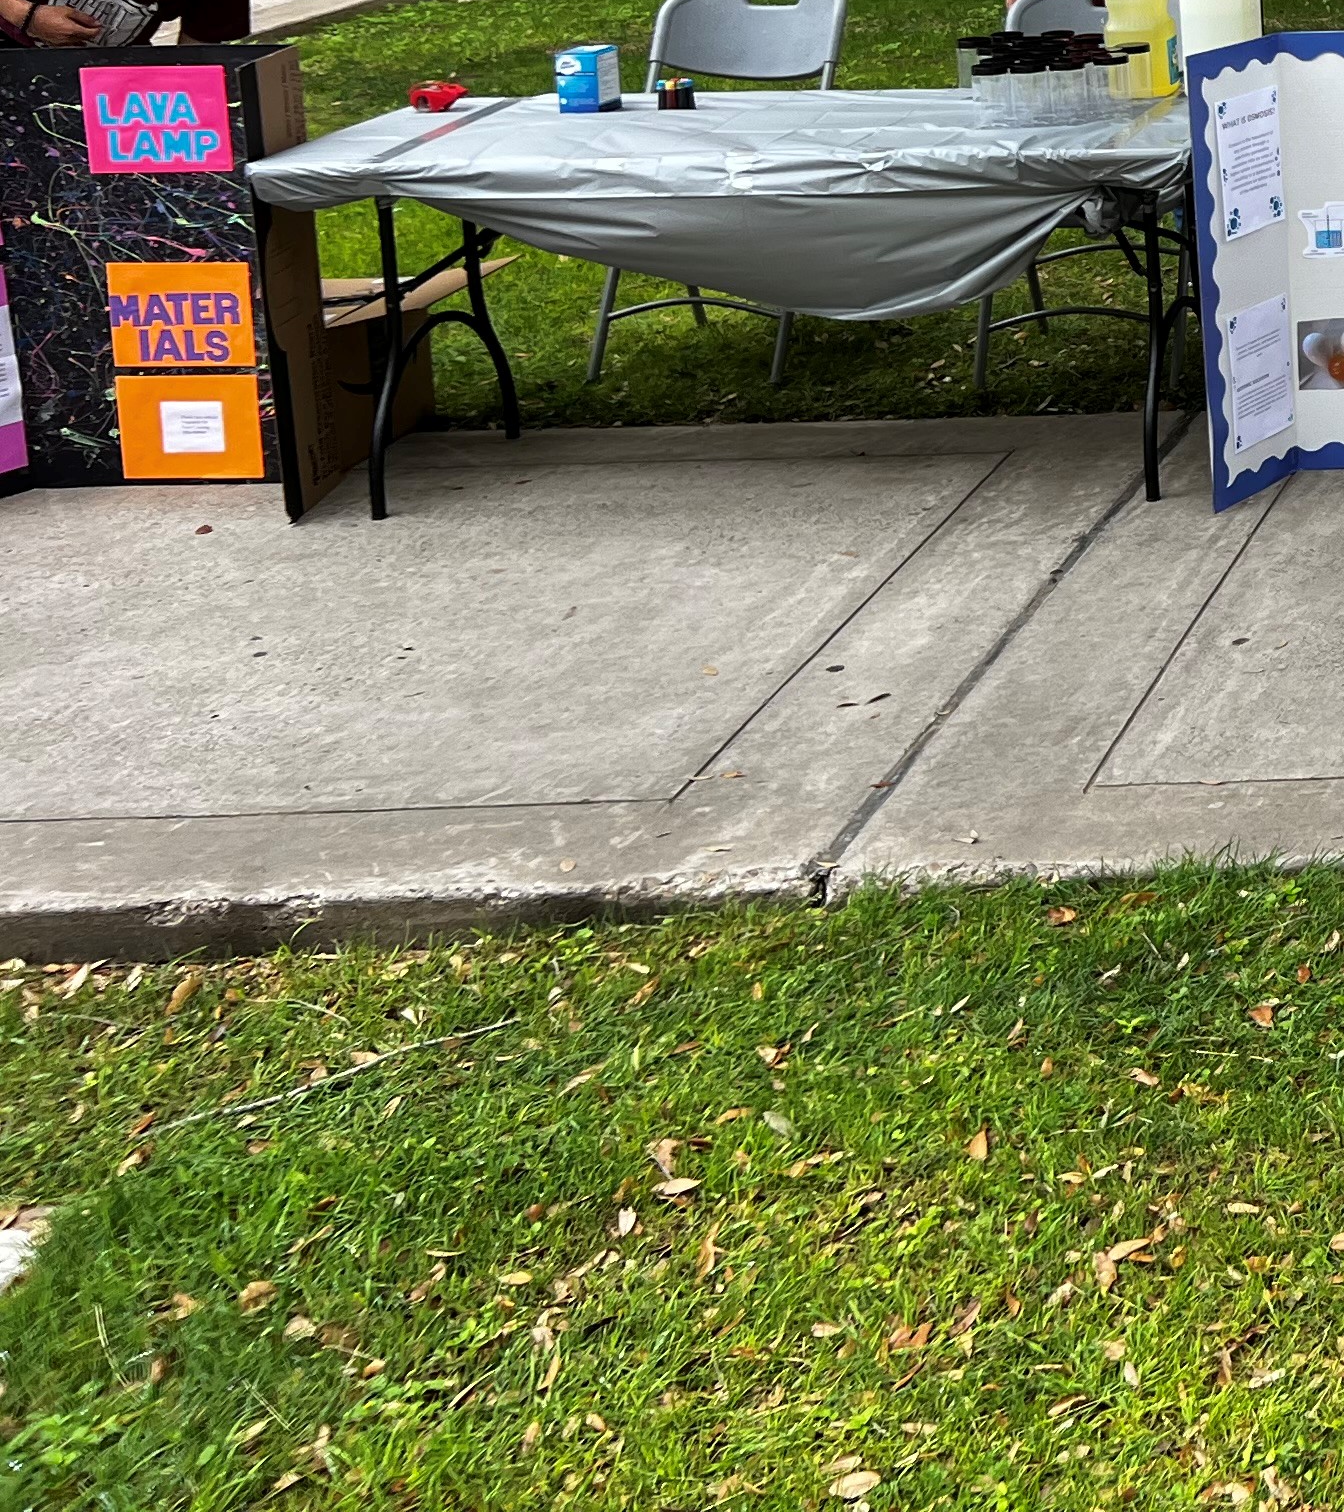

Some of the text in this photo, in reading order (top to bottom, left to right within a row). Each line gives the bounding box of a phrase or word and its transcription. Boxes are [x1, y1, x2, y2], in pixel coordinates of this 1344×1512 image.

[97, 91, 199, 126] LAVA
[108, 130, 219, 163] LAMP
[109, 292, 241, 328] MATER
[139, 330, 230, 363] IALS
